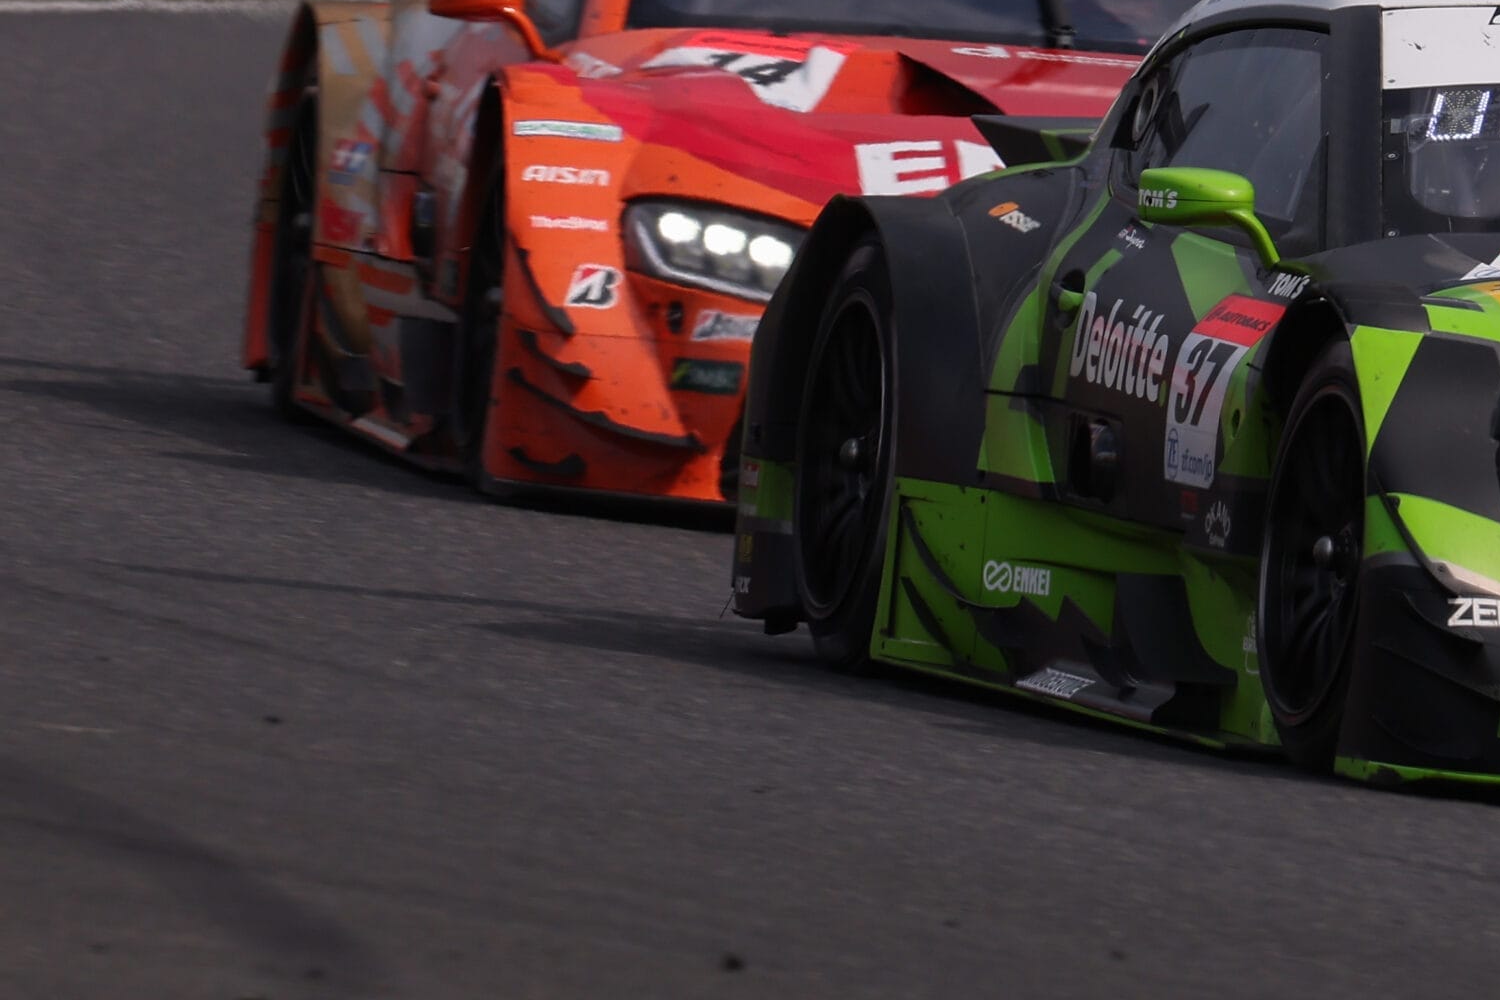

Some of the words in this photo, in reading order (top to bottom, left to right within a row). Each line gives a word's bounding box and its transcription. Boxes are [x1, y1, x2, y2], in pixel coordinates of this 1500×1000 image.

[1267, 272, 1311, 300] TOM'S
[1174, 338, 1238, 427] 37
[1012, 565, 1051, 596] ENKEI
